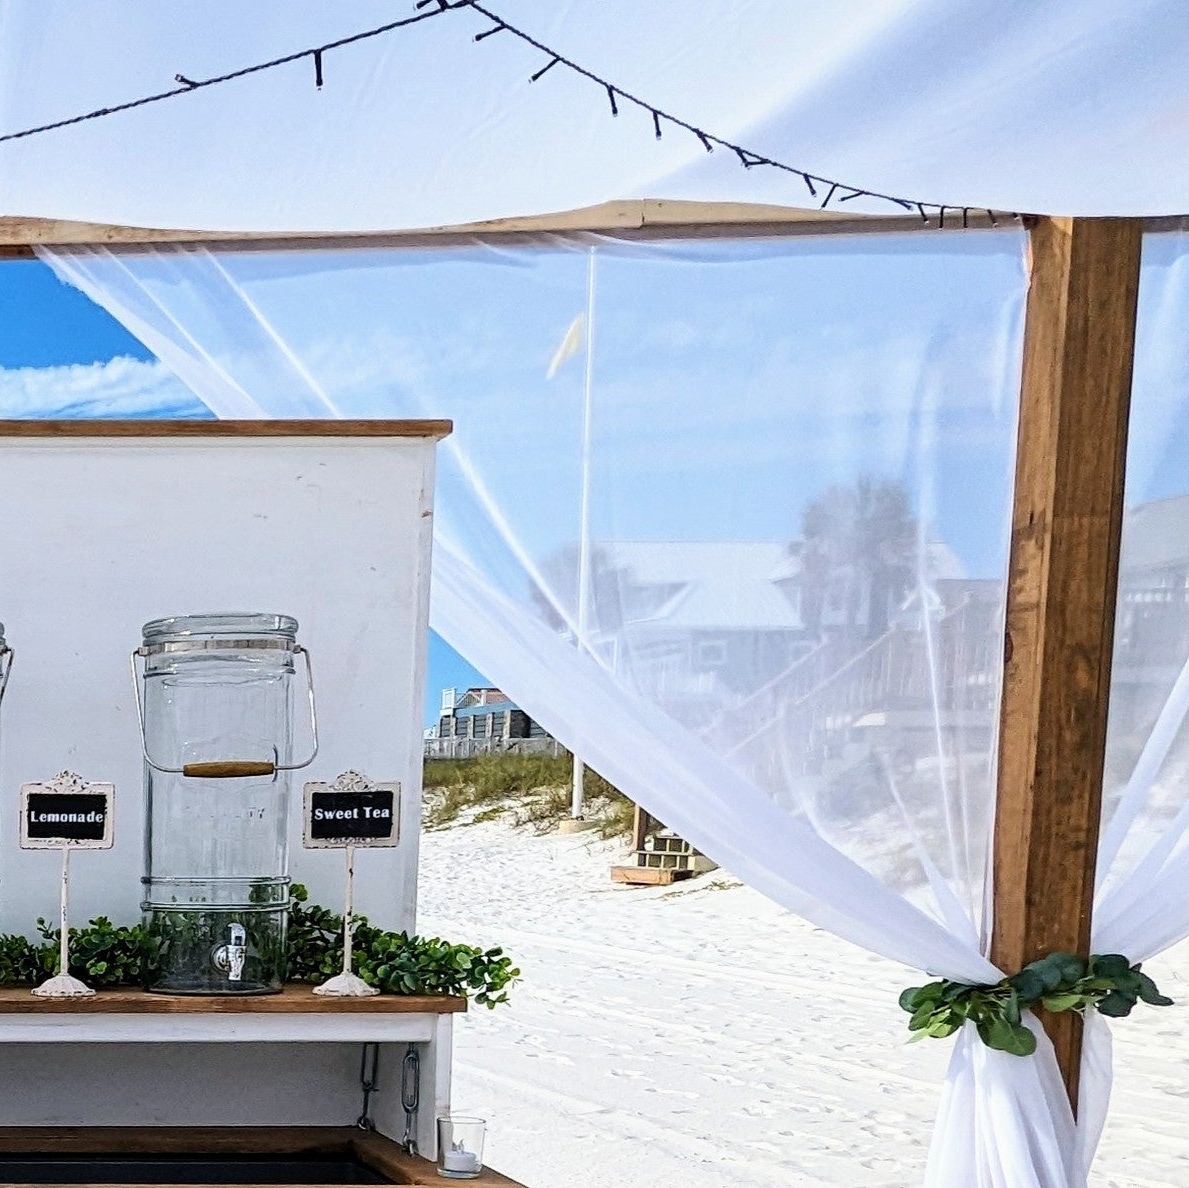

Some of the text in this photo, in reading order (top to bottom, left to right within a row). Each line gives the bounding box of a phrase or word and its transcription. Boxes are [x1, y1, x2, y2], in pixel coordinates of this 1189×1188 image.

[30, 810, 104, 823] Lemonade
[314, 806, 390, 820] Sweet Tea
